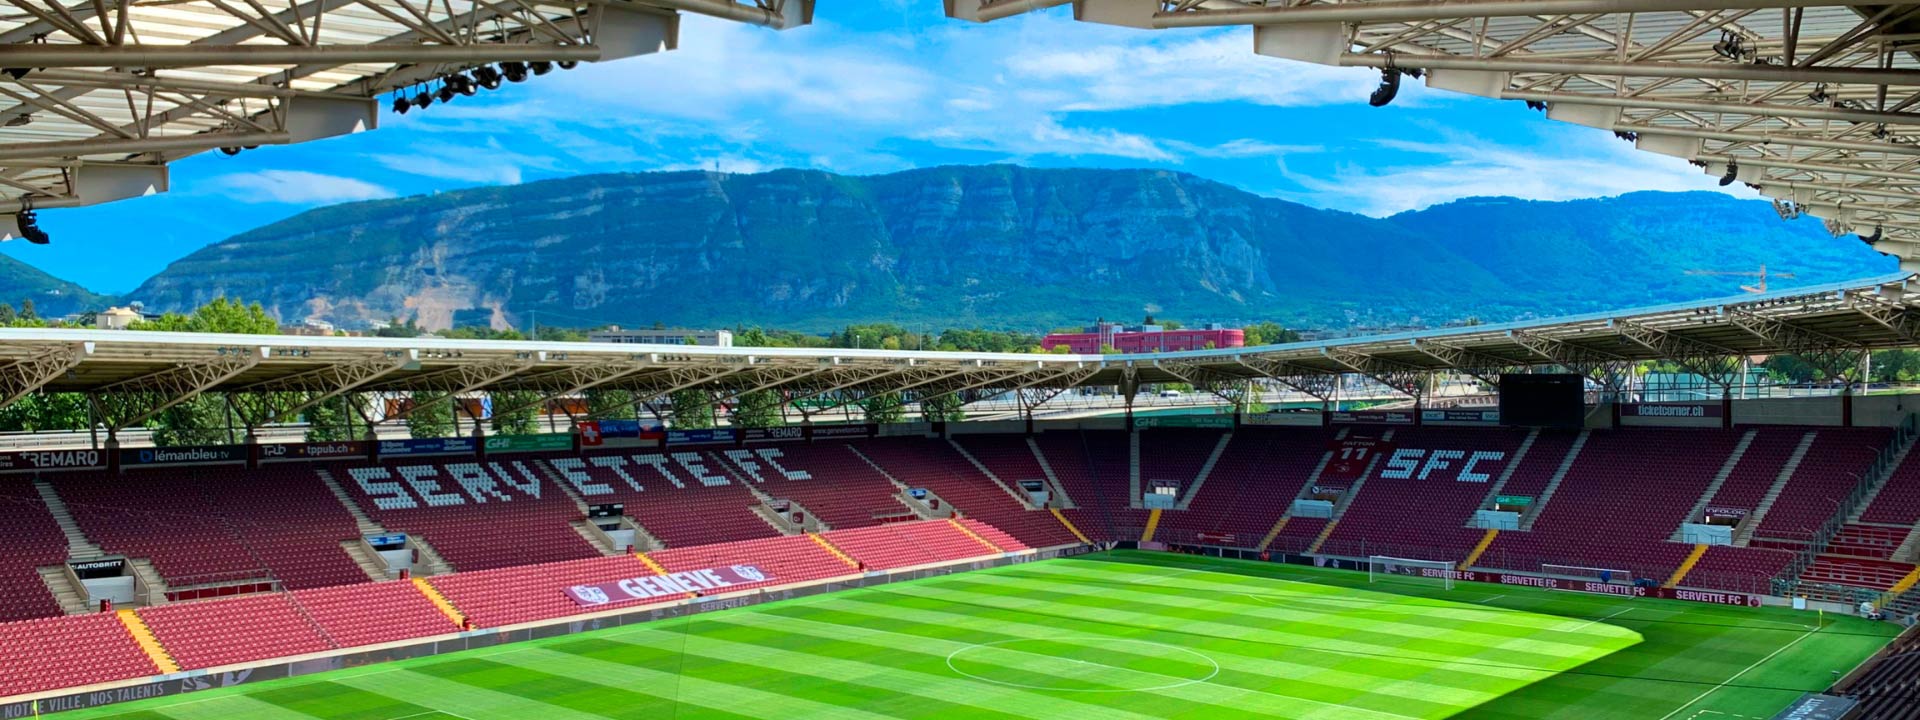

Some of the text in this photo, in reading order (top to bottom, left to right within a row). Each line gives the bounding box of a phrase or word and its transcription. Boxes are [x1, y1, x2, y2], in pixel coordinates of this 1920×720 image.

[1638, 405, 1704, 416] ticketcorner.ch
[307, 444, 348, 455] tppub.ch
[1341, 447, 1368, 460] 11
[1381, 448, 1505, 483] SFC
[348, 448, 812, 510] SERVETTE FC
[77, 560, 122, 569] AUTOBRITT
[1464, 572, 1475, 580] FC
[1501, 575, 1557, 588] SERVETTE FC
[618, 569, 732, 598] GENEVE
[1585, 582, 1645, 596] SERVETTE FC
[1676, 590, 1741, 605] SERVETTE FC
[90, 693, 113, 706] NOS
[117, 683, 164, 702] TALENTS
